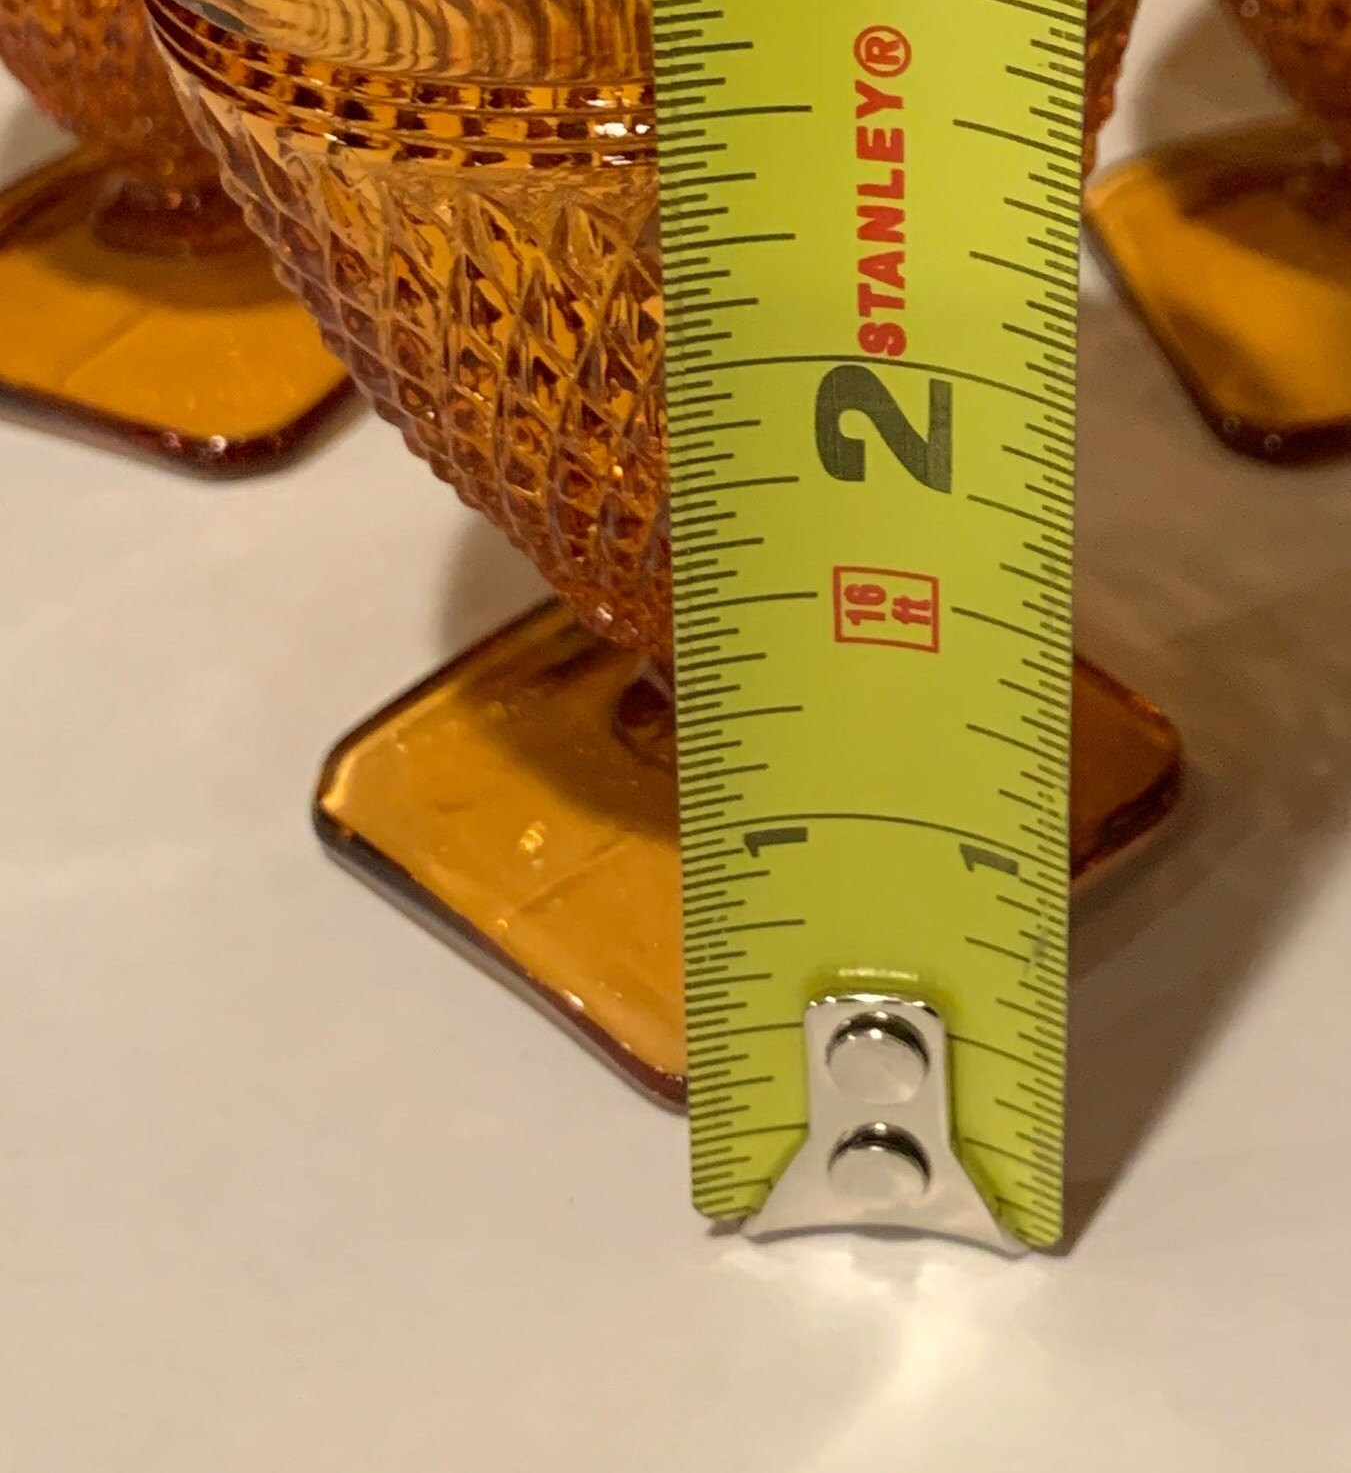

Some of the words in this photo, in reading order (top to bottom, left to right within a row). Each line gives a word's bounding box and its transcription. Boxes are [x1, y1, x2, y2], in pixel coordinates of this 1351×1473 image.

[814, 364, 953, 495] 2
[844, 583, 887, 626] 16
[891, 595, 932, 626] ft
[743, 826, 809, 858] 1
[958, 843, 1019, 876] 1
